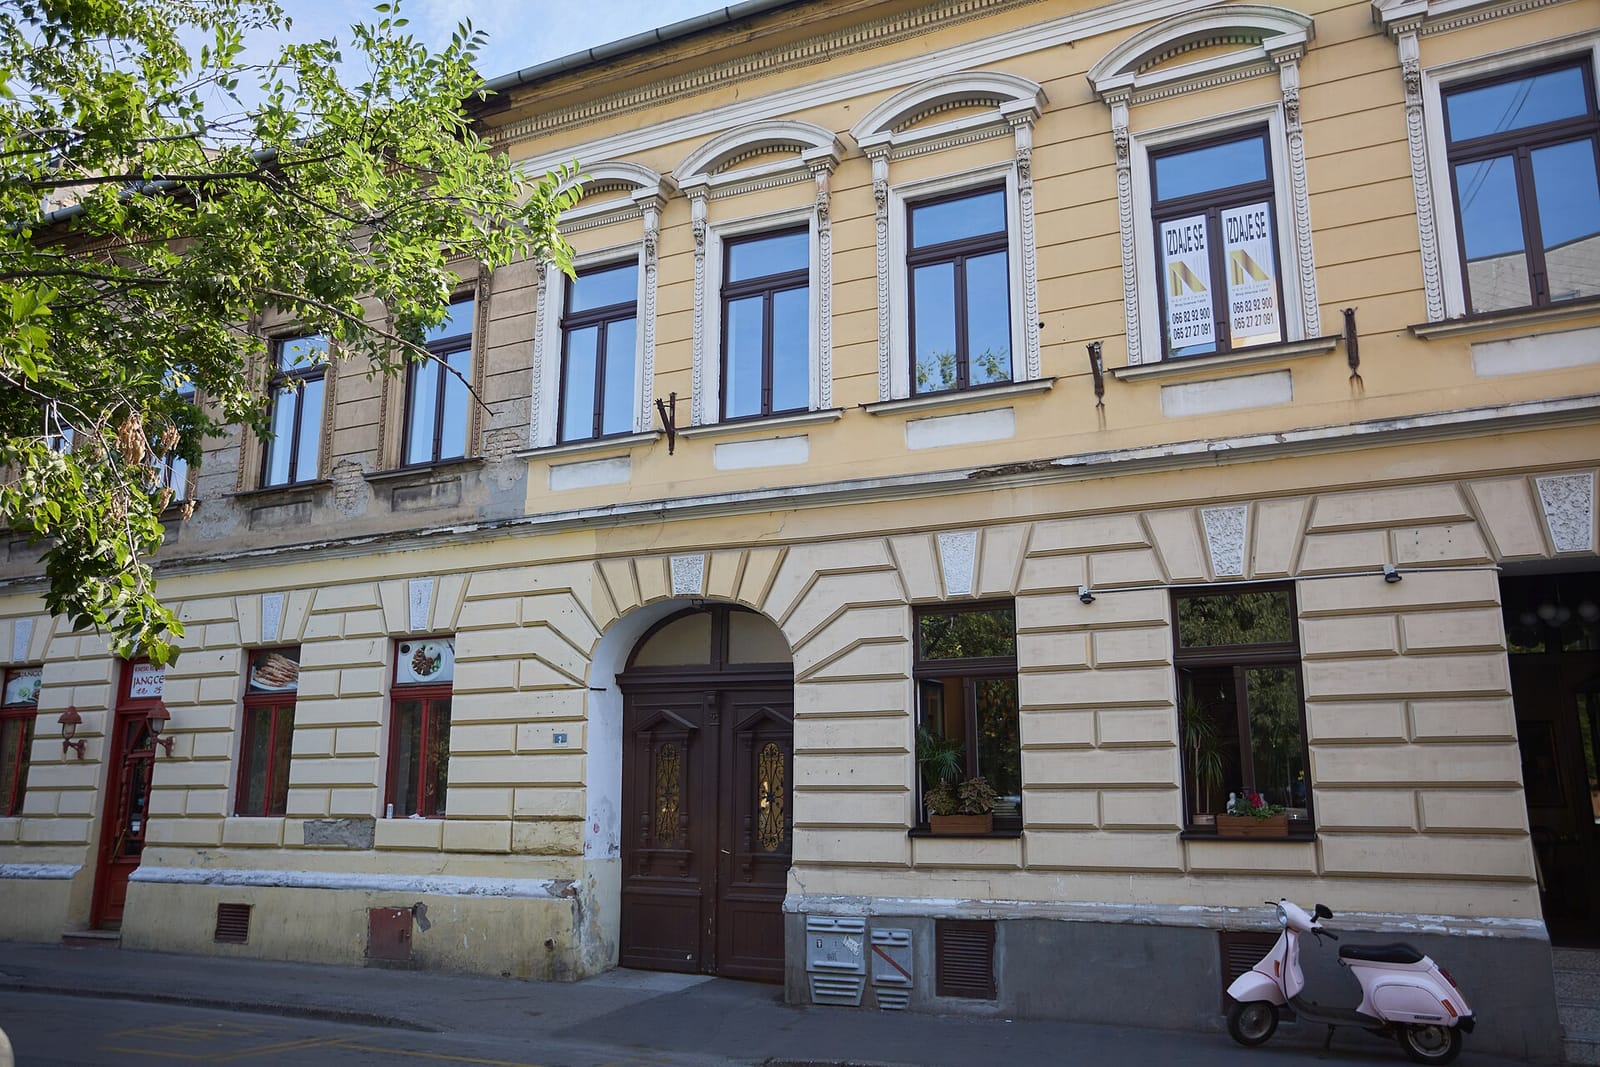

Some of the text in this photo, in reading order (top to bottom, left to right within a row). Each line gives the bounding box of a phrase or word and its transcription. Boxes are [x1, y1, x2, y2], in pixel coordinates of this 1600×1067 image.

[1226, 211, 1267, 244] IZDAJE SE
[1165, 223, 1205, 256] IZDAJE SE
[1233, 297, 1273, 314] 066 82 92 900
[1172, 307, 1210, 325] 066 82 92 900
[1246, 315, 1253, 328] 27
[1254, 314, 1262, 326] 27
[1184, 325, 1192, 338] 27
[1192, 324, 1200, 337] 27
